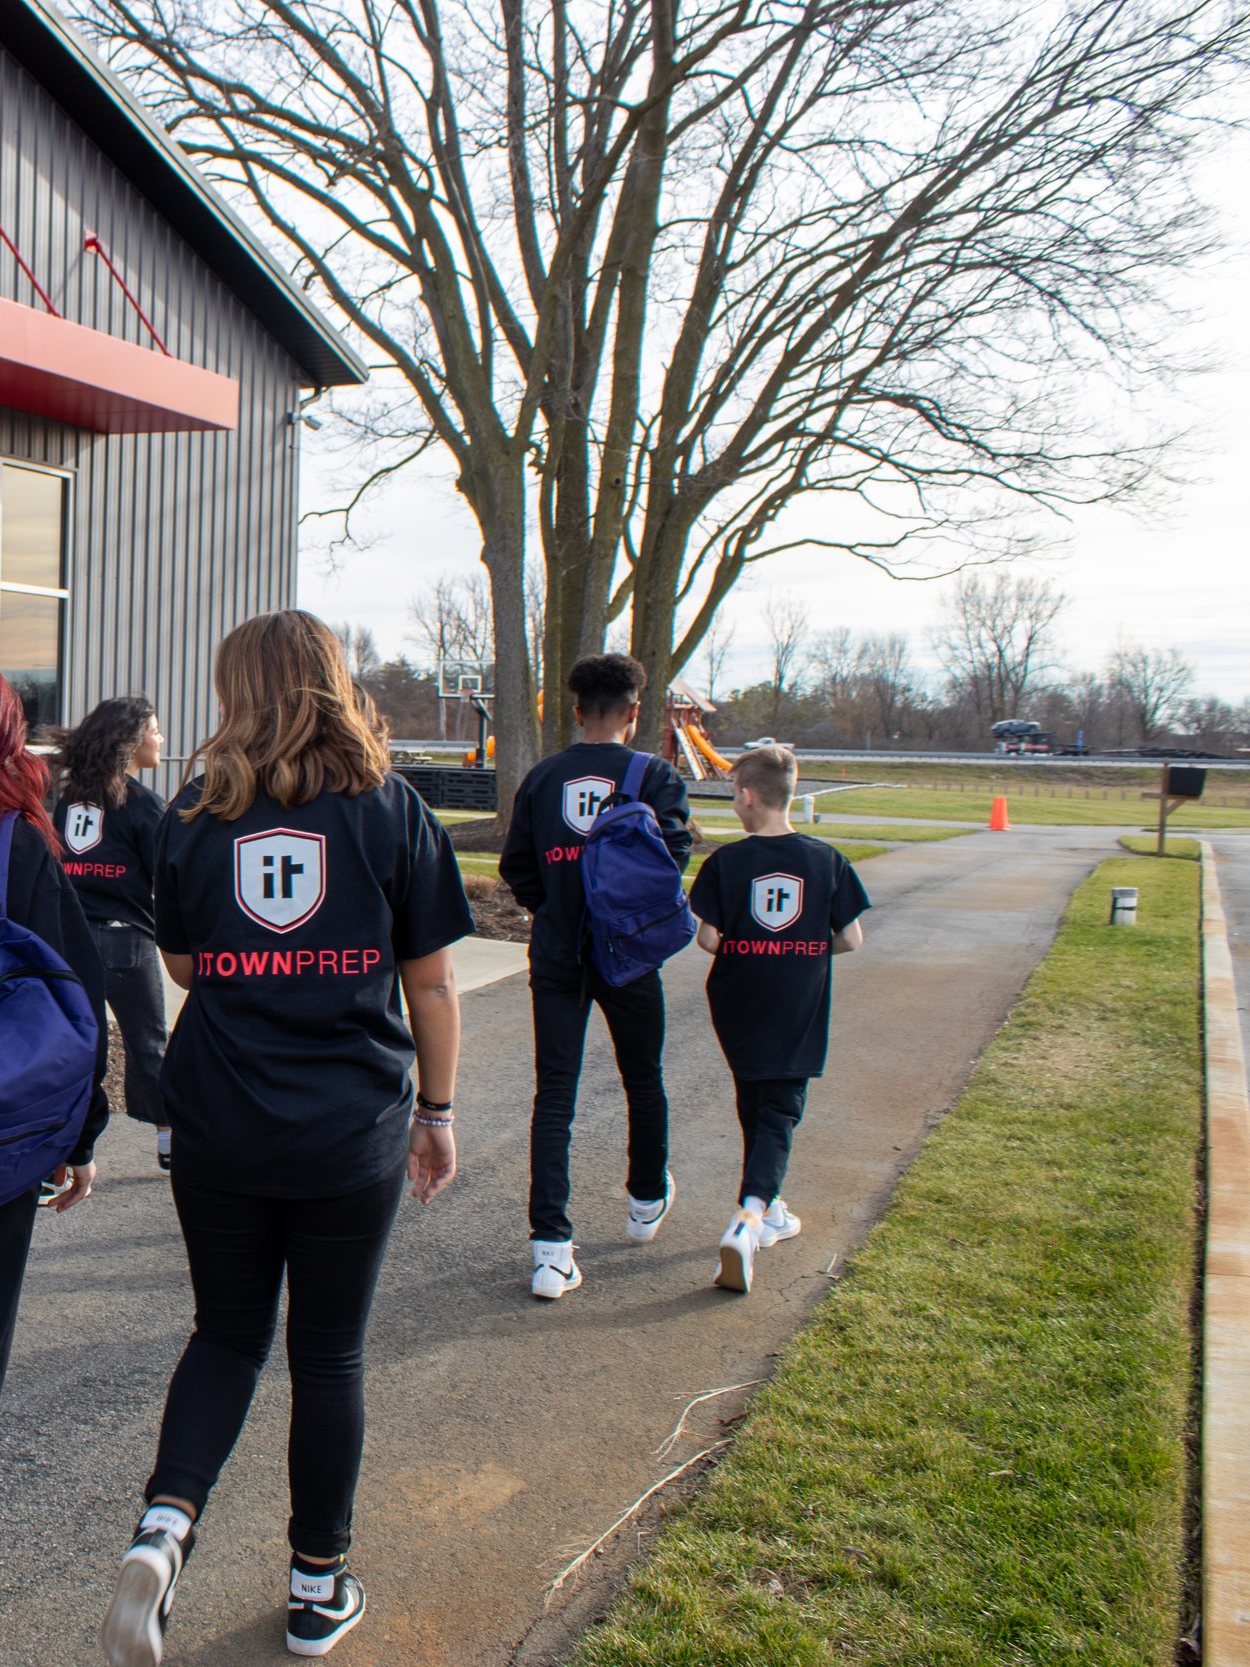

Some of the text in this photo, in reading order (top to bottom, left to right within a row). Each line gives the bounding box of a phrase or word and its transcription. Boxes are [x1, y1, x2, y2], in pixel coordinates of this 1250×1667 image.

[578, 790, 601, 817] it
[74, 814, 93, 837] it
[62, 862, 127, 878] WNPREP
[262, 855, 304, 899] it
[766, 888, 790, 912] it
[723, 940, 828, 956] ITOWNPREP
[198, 949, 381, 977] ITOWNPREP
[301, 1583, 322, 1594] NIKE
